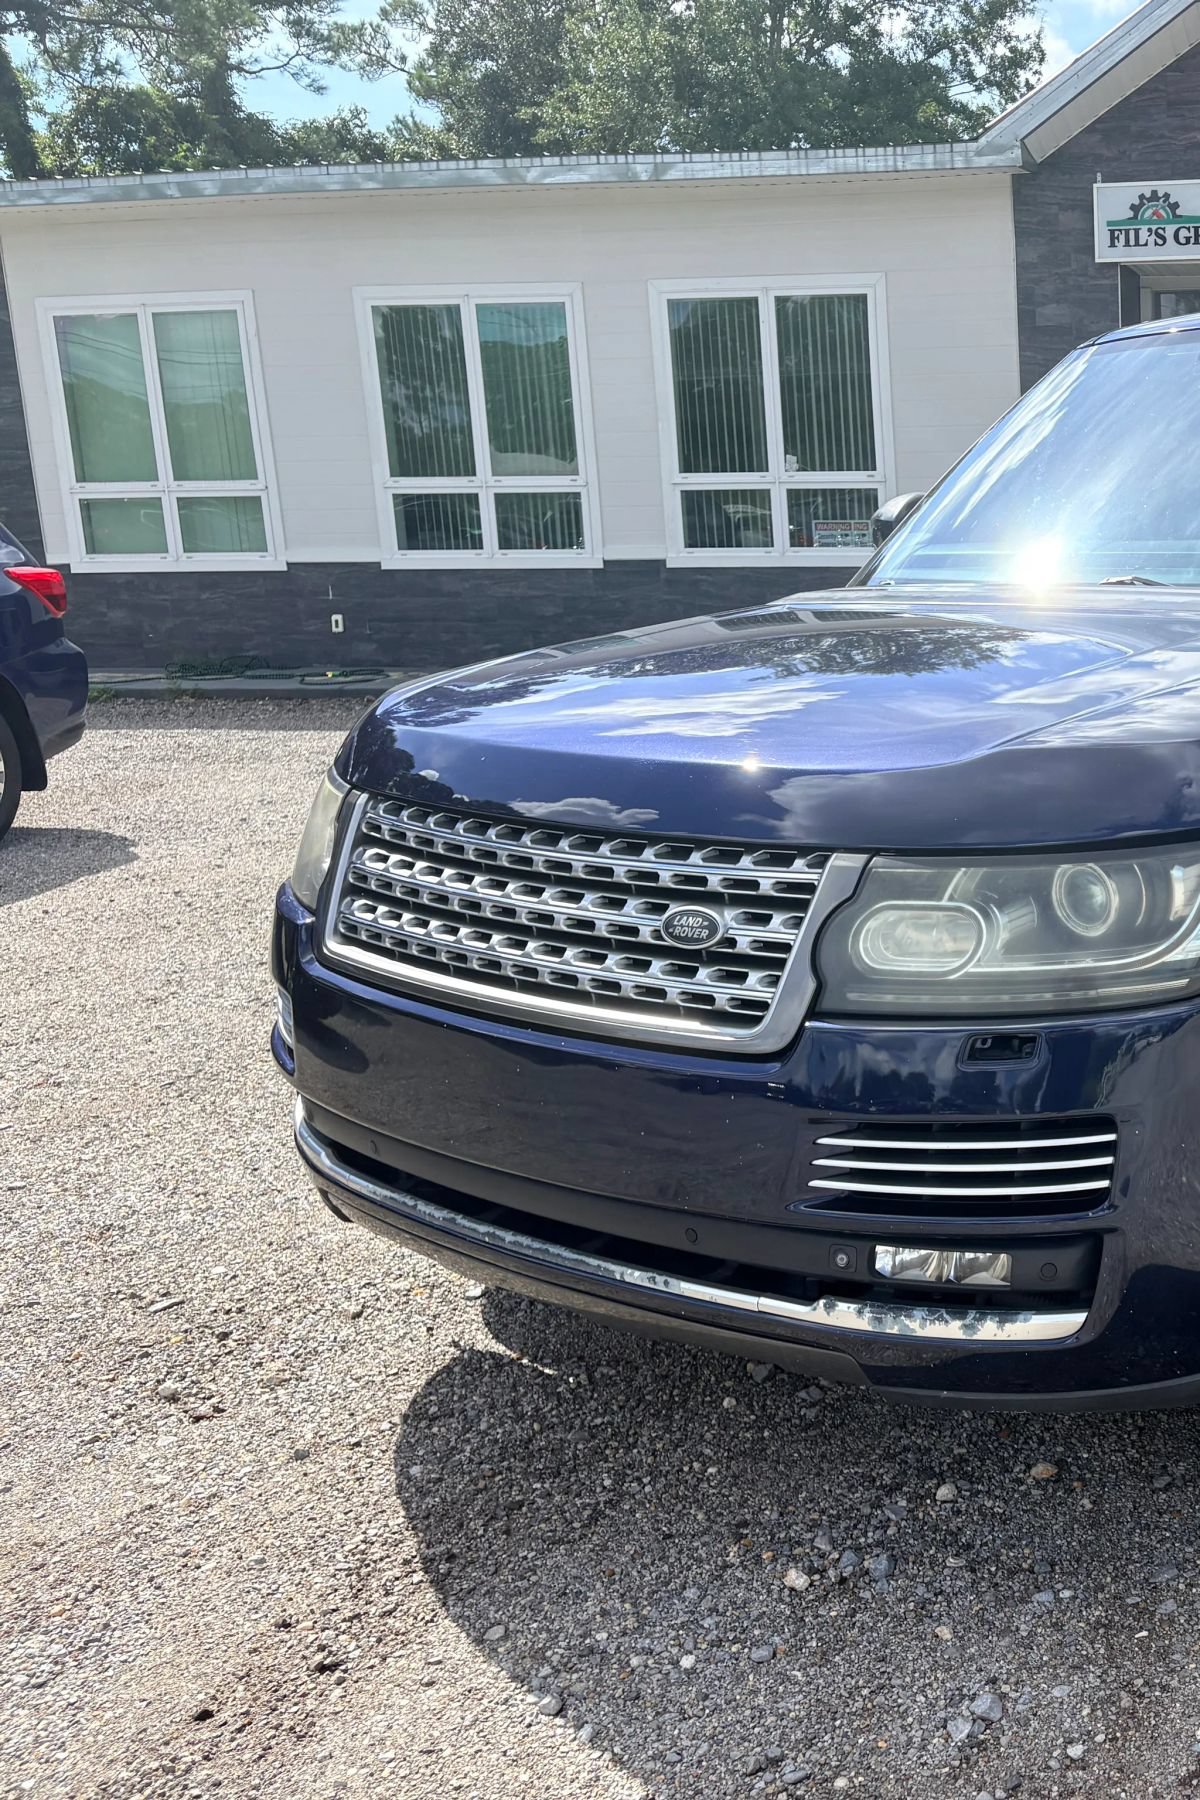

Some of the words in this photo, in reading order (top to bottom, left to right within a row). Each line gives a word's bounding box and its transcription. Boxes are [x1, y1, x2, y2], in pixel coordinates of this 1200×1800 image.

[1107, 227, 1167, 248] FIL'S
[673, 915, 703, 928] LAND
[672, 926, 709, 940] ROVER
